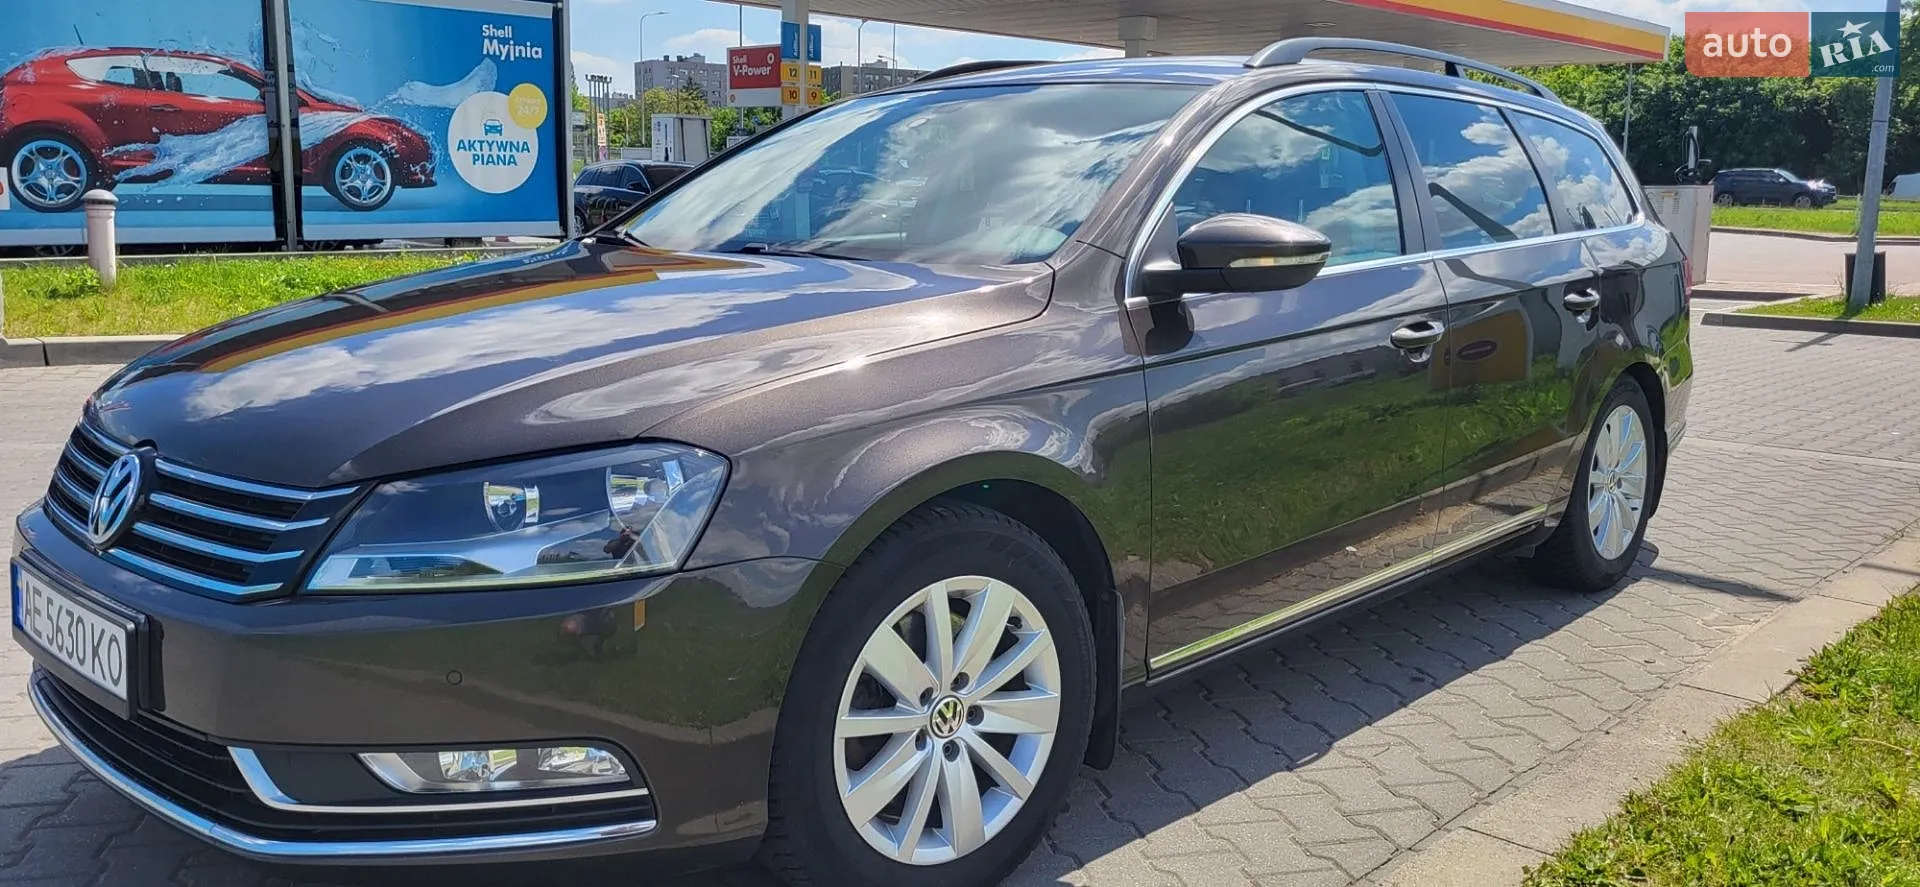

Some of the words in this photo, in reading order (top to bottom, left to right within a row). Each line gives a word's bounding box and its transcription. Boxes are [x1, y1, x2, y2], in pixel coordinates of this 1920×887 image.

[482, 24, 512, 38] Shell
[482, 39, 542, 61] Myjnia
[732, 55, 747, 64] Shell
[733, 64, 772, 77] V-Power
[788, 68, 797, 78] 12
[809, 70, 817, 79] 11
[788, 89, 797, 99] 10
[811, 91, 817, 100] 9
[456, 139, 530, 153] AKTYWNA
[472, 154, 517, 166] PIANA
[25, 580, 42, 640] AE
[46, 595, 86, 666] 5630
[91, 622, 122, 687] KO
